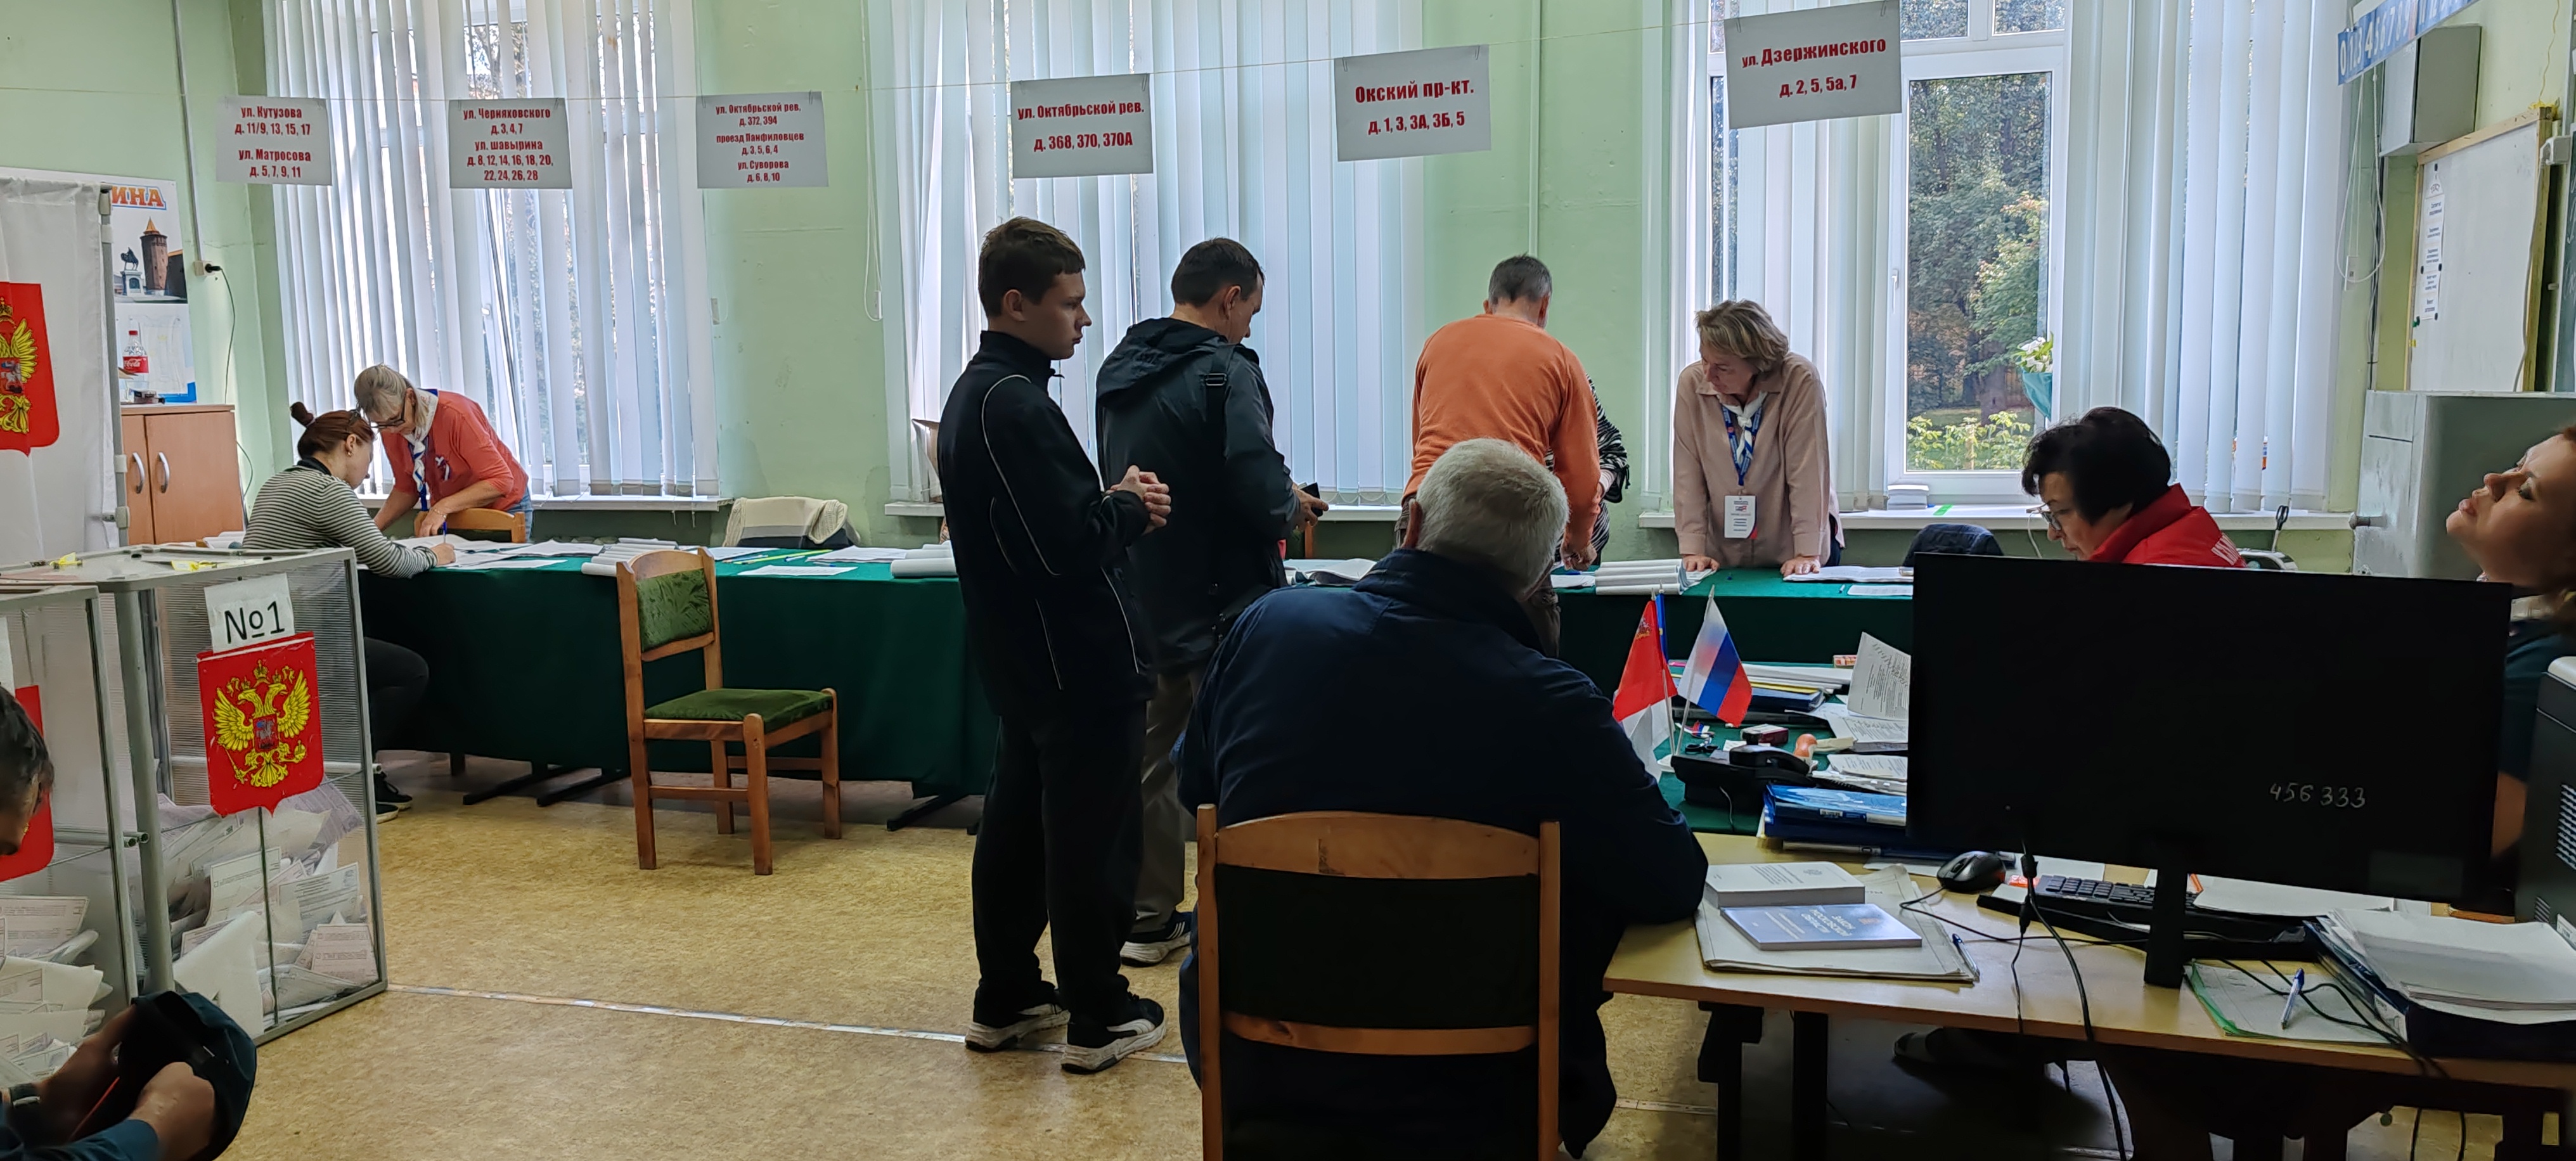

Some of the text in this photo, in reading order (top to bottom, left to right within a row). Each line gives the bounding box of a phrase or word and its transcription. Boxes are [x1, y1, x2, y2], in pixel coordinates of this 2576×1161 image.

[1742, 39, 1886, 68] ул. Дзержинского
[1355, 80, 1474, 103] Окский пр-кт.
[1779, 74, 1857, 98] д. 2, 5, 5а, 7
[241, 106, 302, 119] ул. Кутузова
[463, 108, 551, 120] ул. Черняховского
[716, 106, 727, 115] ул.
[729, 102, 782, 114] Октябрьской
[1017, 100, 1145, 120] ул. Октябрьской рев.
[739, 115, 777, 127] д. 372, 394
[1368, 111, 1465, 136] д. 1, 3, 3А, 3Б, 5
[235, 122, 311, 136] д. 11/9, 13, 15, 17
[491, 122, 523, 136] д. 3, 4, 7
[716, 132, 804, 144] проезд Панфиловцев
[1033, 132, 1133, 152] д. 368, 370, 370А
[475, 141, 488, 151] ул.
[742, 144, 778, 156] д. 3, 5, 6, 4
[238, 148, 311, 162] ул. Матросова
[467, 155, 553, 167] д. 8, 12, 14, 16, 18, 20,
[738, 160, 789, 170] ул. Суворова
[249, 165, 301, 179] д. 5, 7, 9, 11
[484, 170, 538, 182] 22, 24, 26, 28
[747, 172, 780, 183] д. 6, 8, 10
[2270, 782, 2366, 808] 456 333
